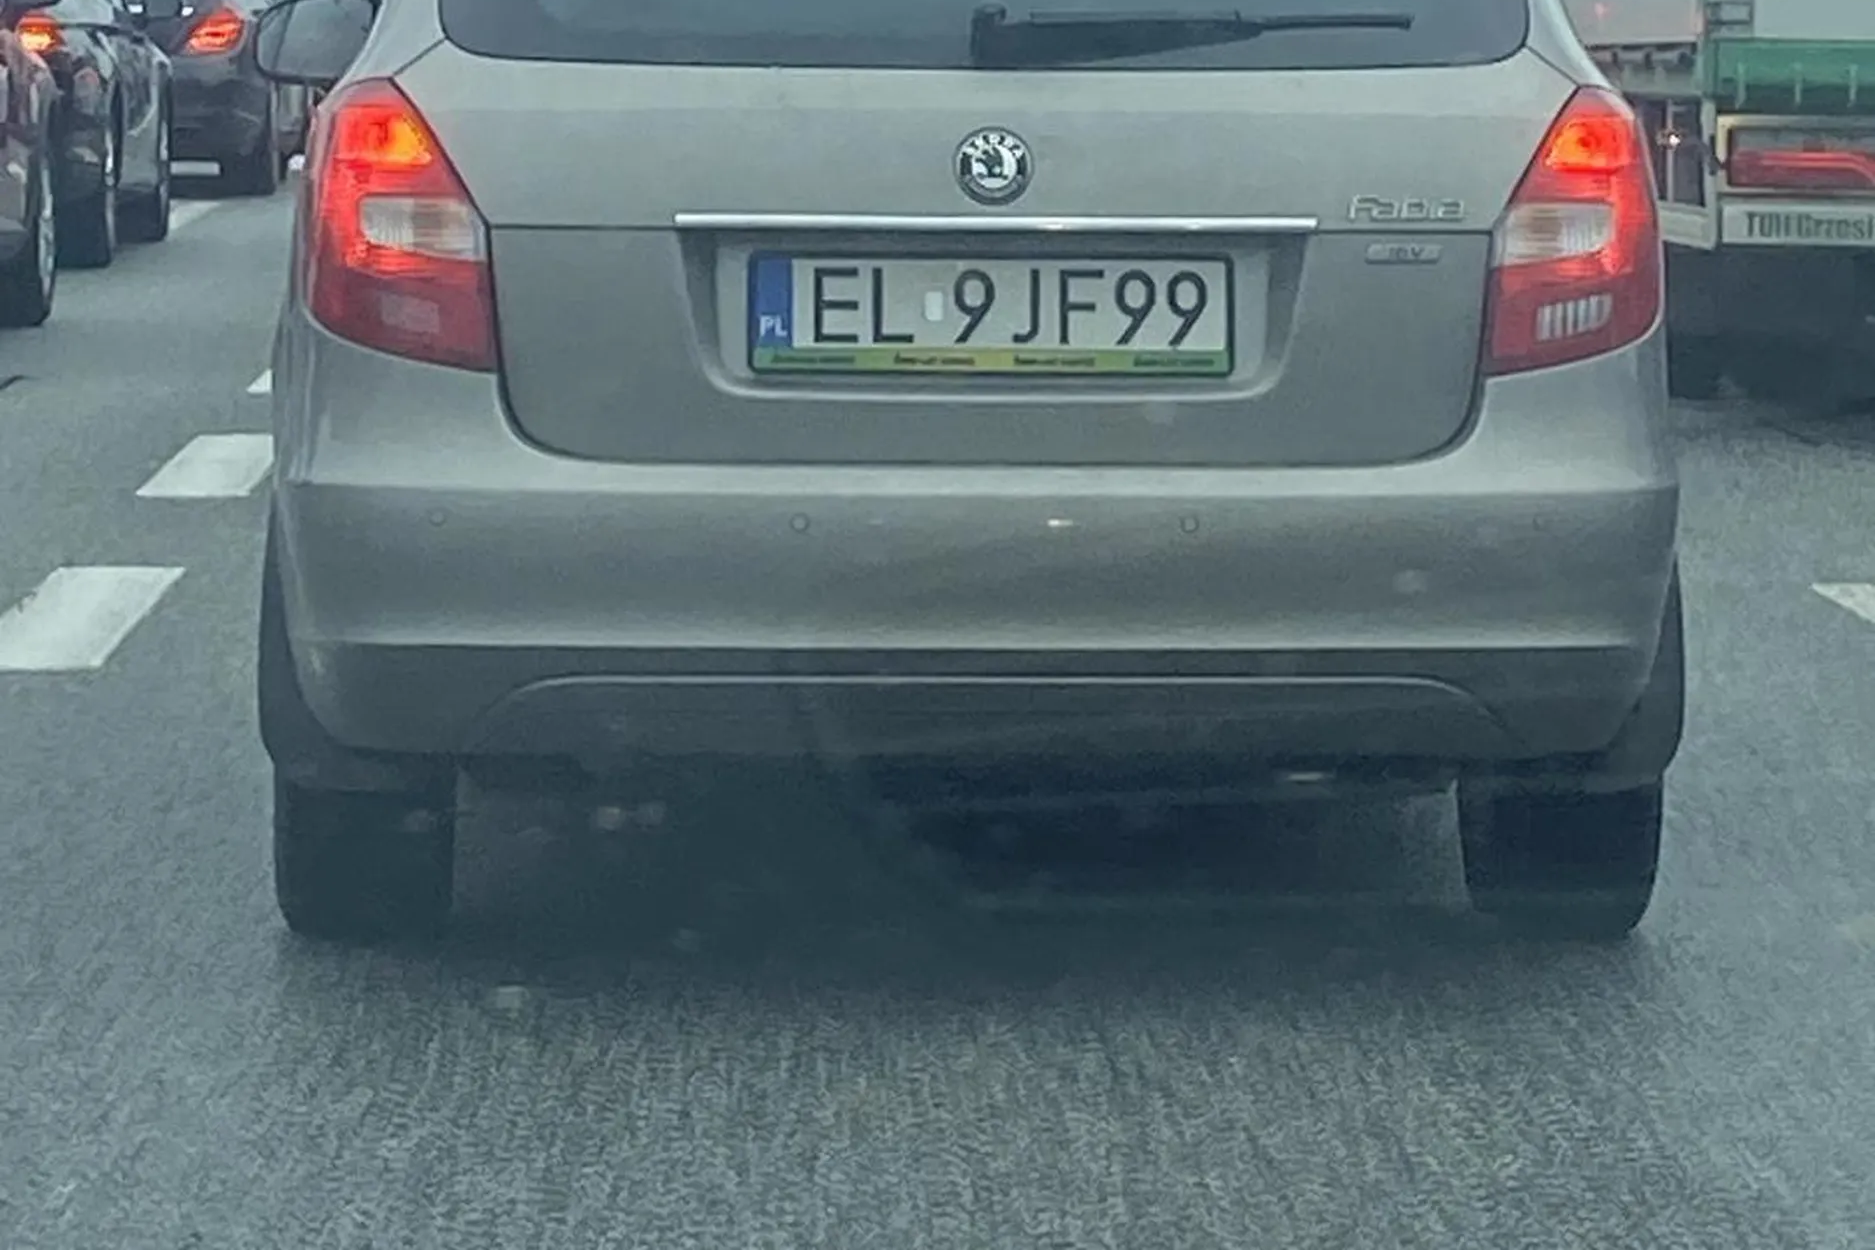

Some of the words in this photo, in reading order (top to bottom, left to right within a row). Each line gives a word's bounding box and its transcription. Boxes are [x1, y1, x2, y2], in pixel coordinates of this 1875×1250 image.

[759, 315, 788, 337] PL
[813, 267, 915, 344] EL
[953, 267, 1208, 347] 9JF99
